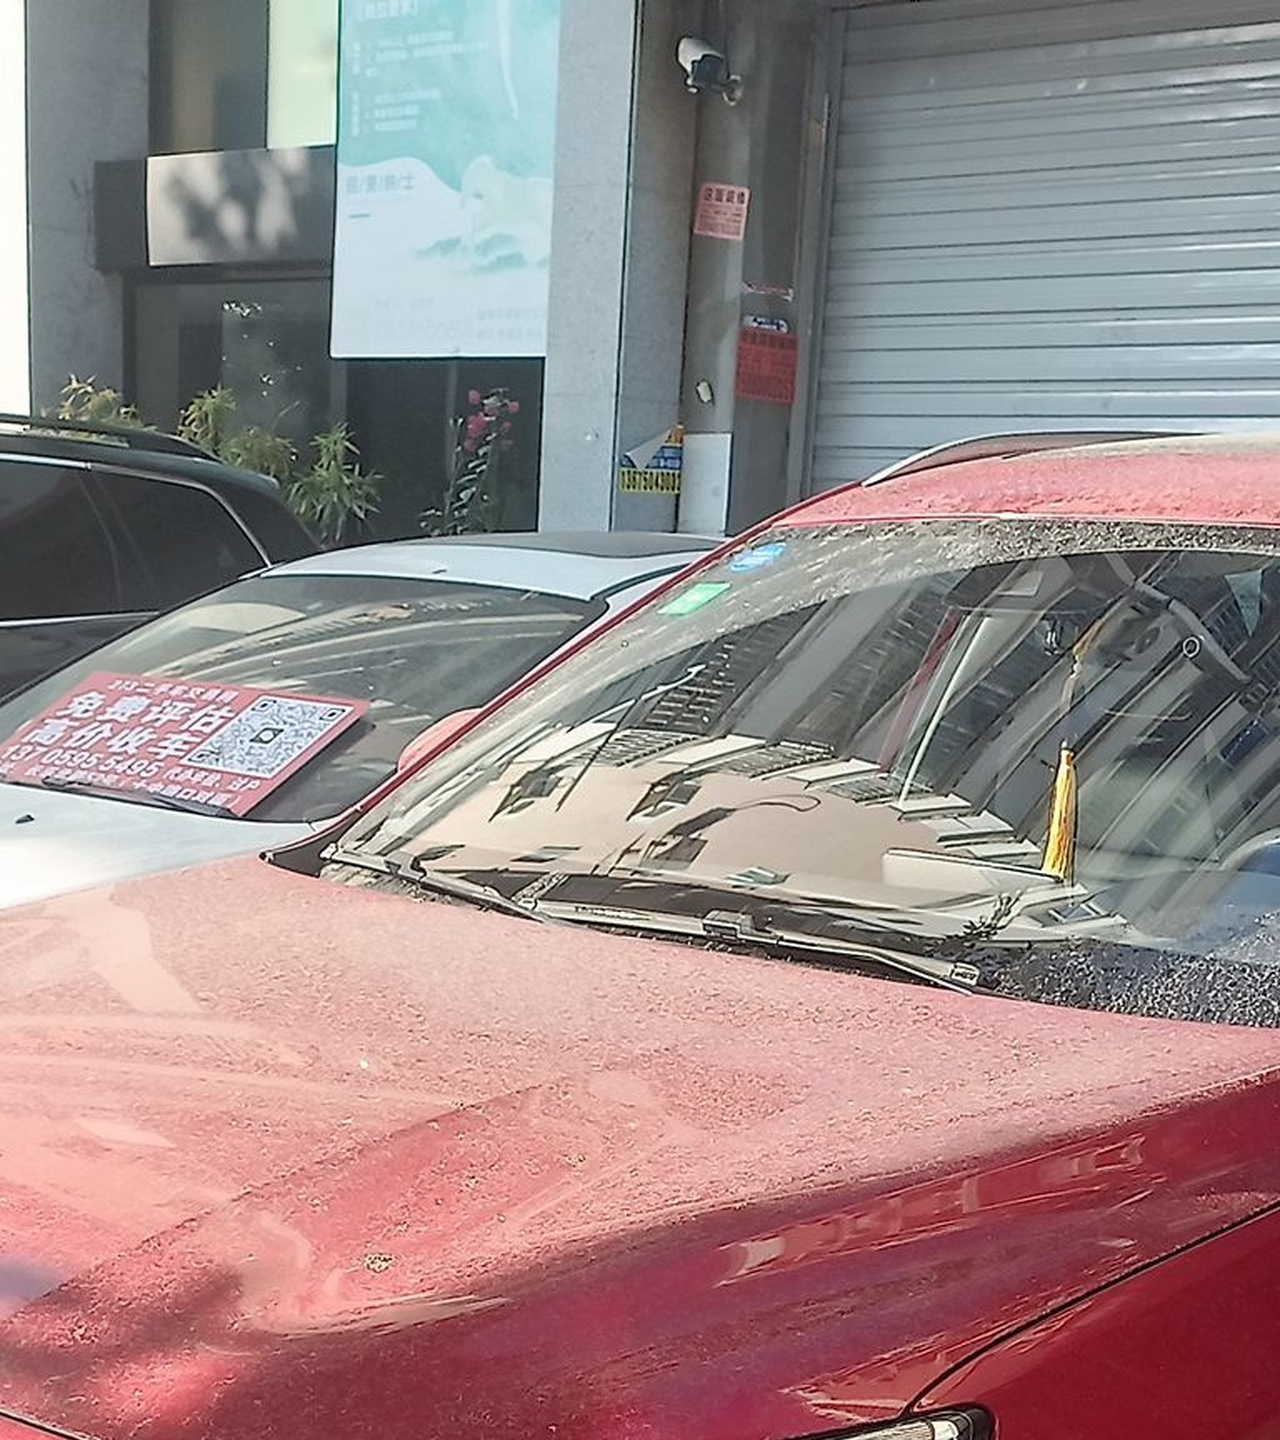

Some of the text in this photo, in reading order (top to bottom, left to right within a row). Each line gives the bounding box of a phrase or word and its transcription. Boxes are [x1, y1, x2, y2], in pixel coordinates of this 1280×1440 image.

[56, 691, 236, 734] 免费评估
[21, 718, 202, 759] 高价收车
[1, 744, 164, 778] 137 0595 5495
